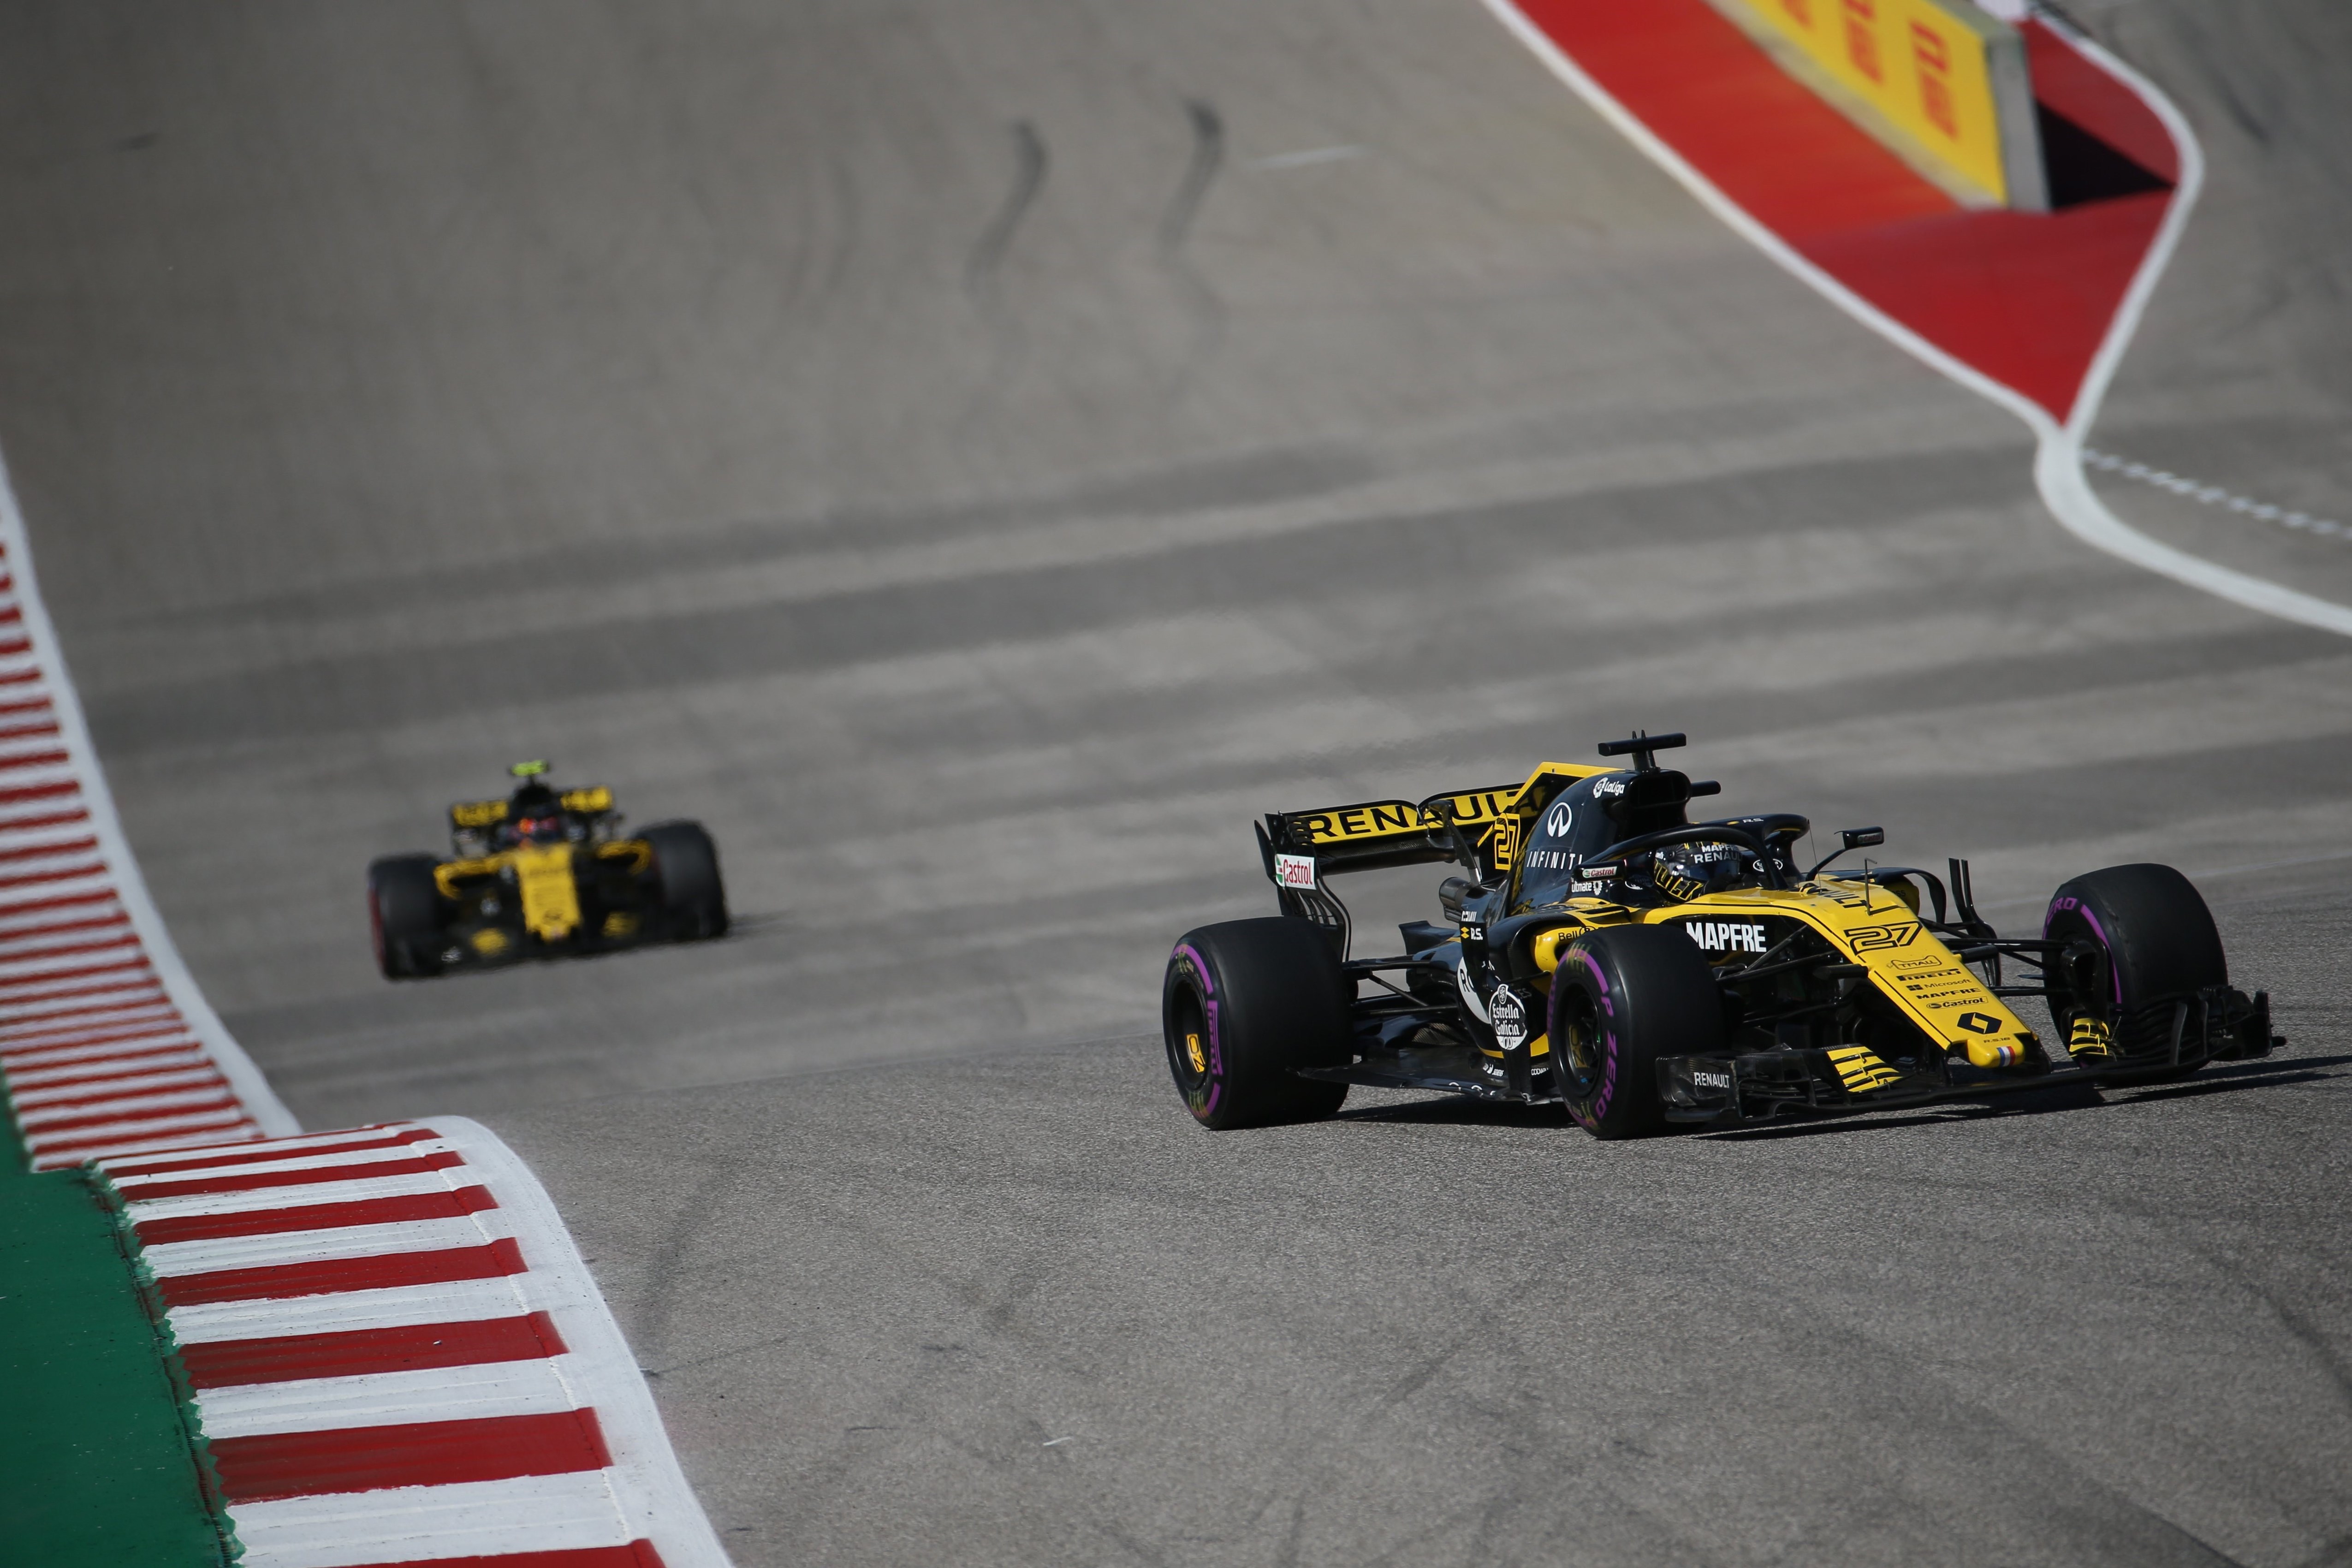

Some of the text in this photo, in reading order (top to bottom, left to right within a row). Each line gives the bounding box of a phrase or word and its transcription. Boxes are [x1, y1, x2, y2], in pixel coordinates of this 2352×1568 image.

[1604, 781, 1625, 796] LaLiga
[1494, 813, 1520, 871] 27
[1526, 850, 1583, 870] INFINITI
[1283, 859, 1313, 885] Castrol
[1591, 867, 1615, 877] Castrol
[1558, 930, 1578, 941] Bell
[1686, 921, 1767, 953] MAPFRE
[1843, 921, 1923, 956] 27
[1897, 959, 1937, 968] TMALL
[1896, 968, 1962, 981] PIRELLI
[1924, 979, 1972, 989] Microsoft
[1916, 987, 1982, 999] MAPFRE
[1941, 998, 1985, 1008] Castrol
[1492, 1004, 1520, 1019] Estrella
[1495, 1019, 1520, 1036] Galicia
[1693, 1071, 1729, 1089] RENAULT
